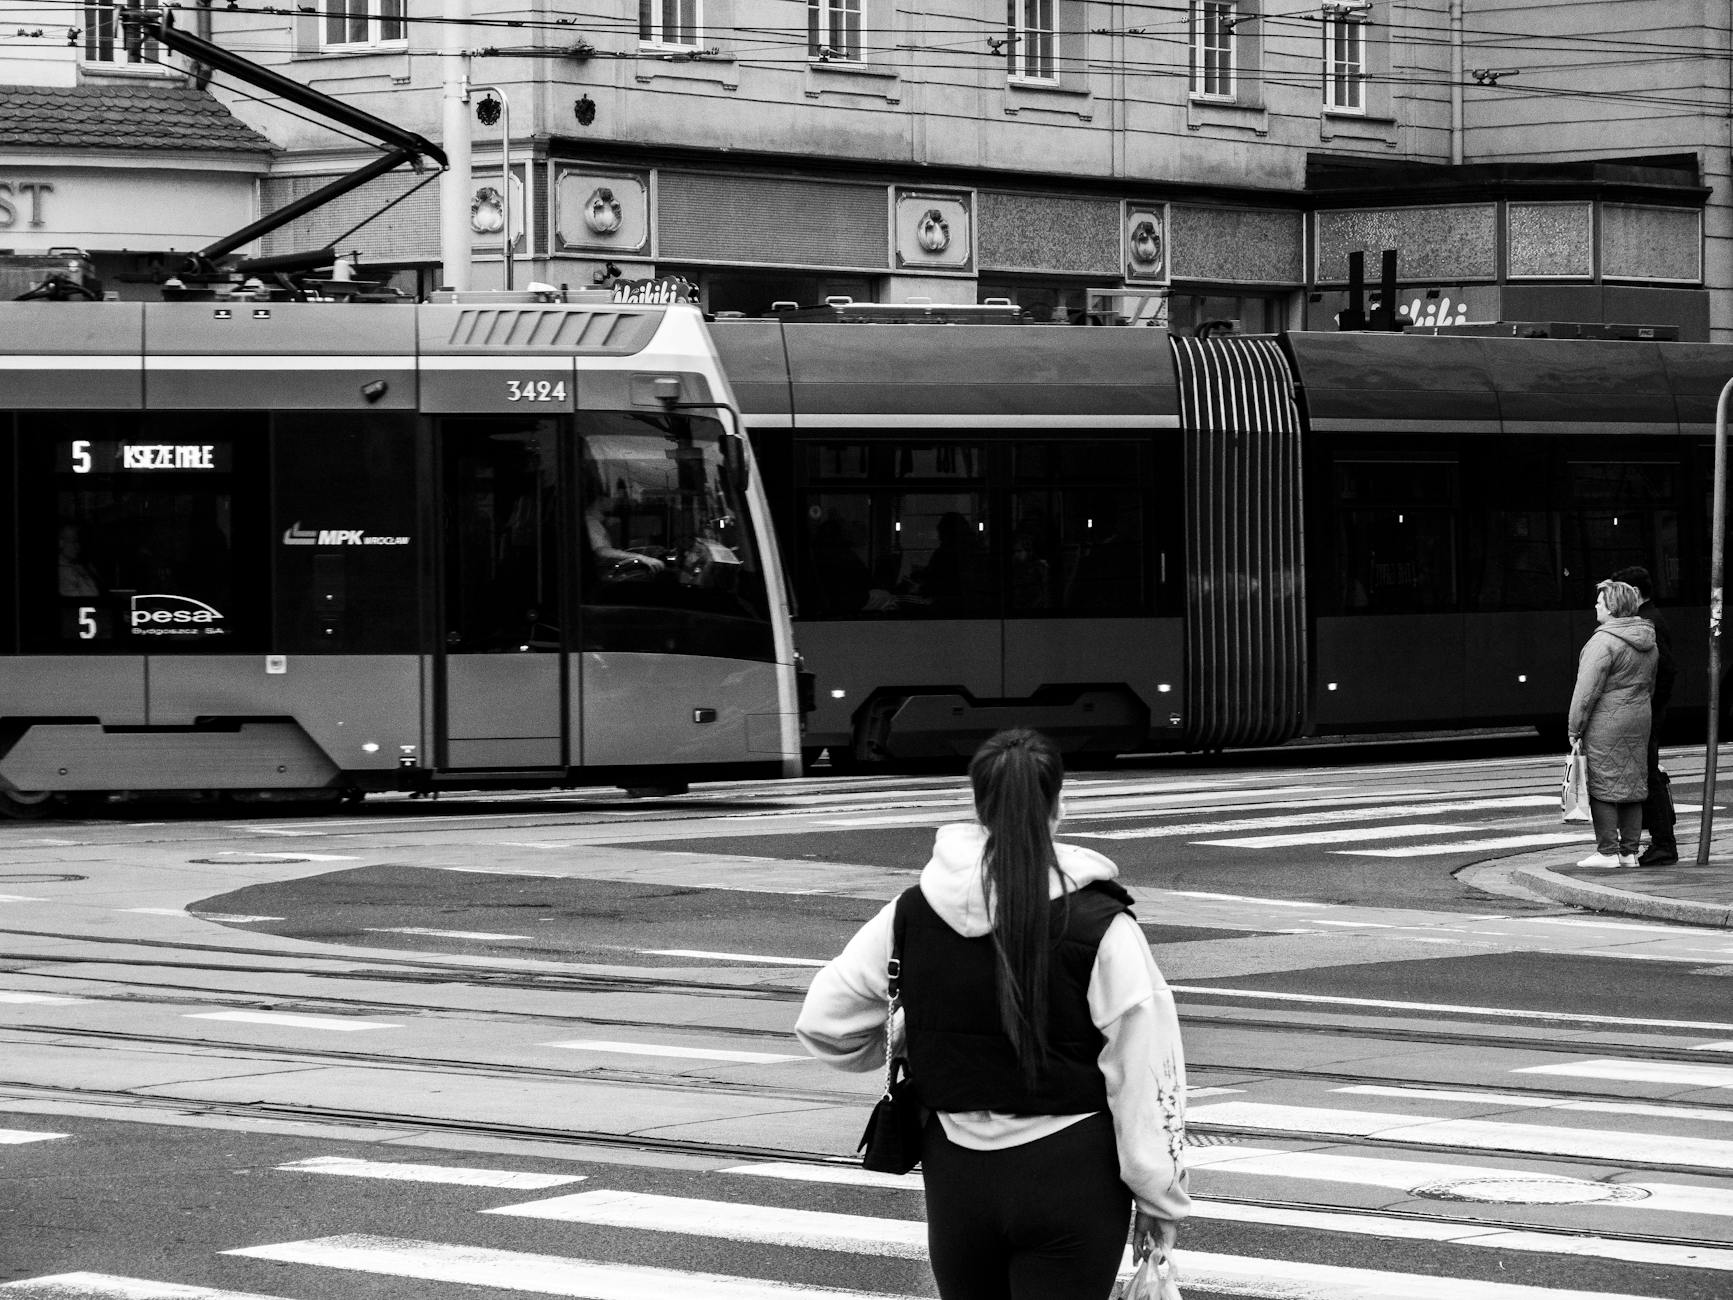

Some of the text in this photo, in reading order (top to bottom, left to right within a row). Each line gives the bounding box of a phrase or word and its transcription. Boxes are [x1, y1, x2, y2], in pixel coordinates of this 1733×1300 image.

[507, 380, 566, 401] 3424
[72, 440, 91, 473] 5
[318, 530, 364, 545] MPK
[79, 607, 97, 639] 5
[131, 610, 214, 626] pesa
